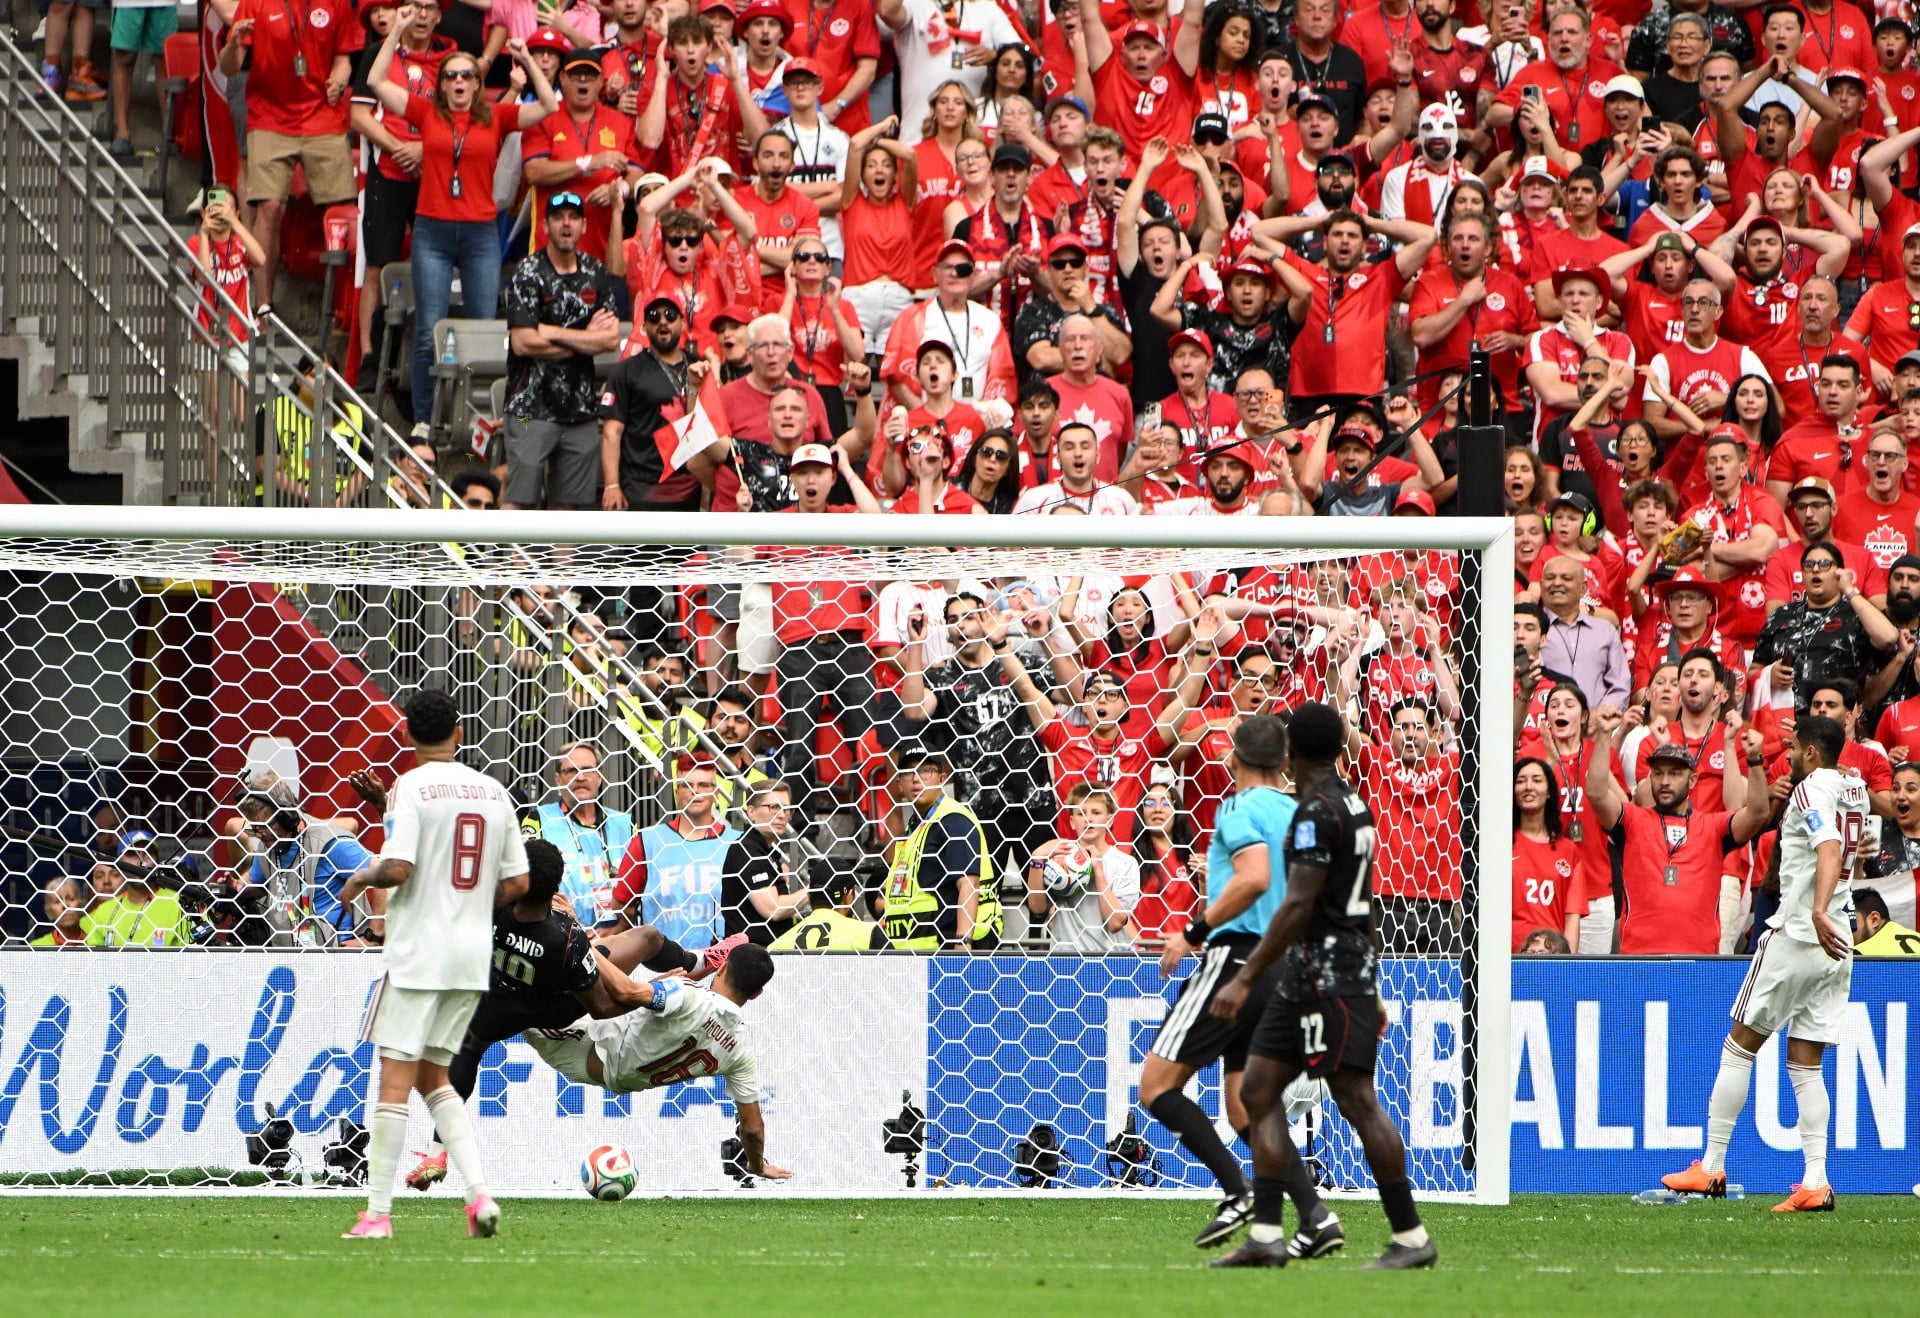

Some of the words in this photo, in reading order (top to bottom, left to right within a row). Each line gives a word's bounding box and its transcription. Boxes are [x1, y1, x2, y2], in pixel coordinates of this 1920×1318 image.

[1830, 165, 1852, 190] 19
[1665, 319, 1685, 343] 19
[1785, 362, 1821, 383] CAN
[1865, 542, 1907, 552] CANADA
[1245, 583, 1320, 605] CANADA
[419, 784, 489, 803] EDMILSON
[490, 783, 505, 803] JR
[1560, 786, 1585, 813] 22
[452, 812, 488, 892] 8
[661, 864, 722, 897] FIF
[1525, 877, 1556, 906] 20
[505, 932, 546, 958] DAVID
[478, 1032, 738, 1118] FIA
[1106, 996, 1703, 1149] FBALL
